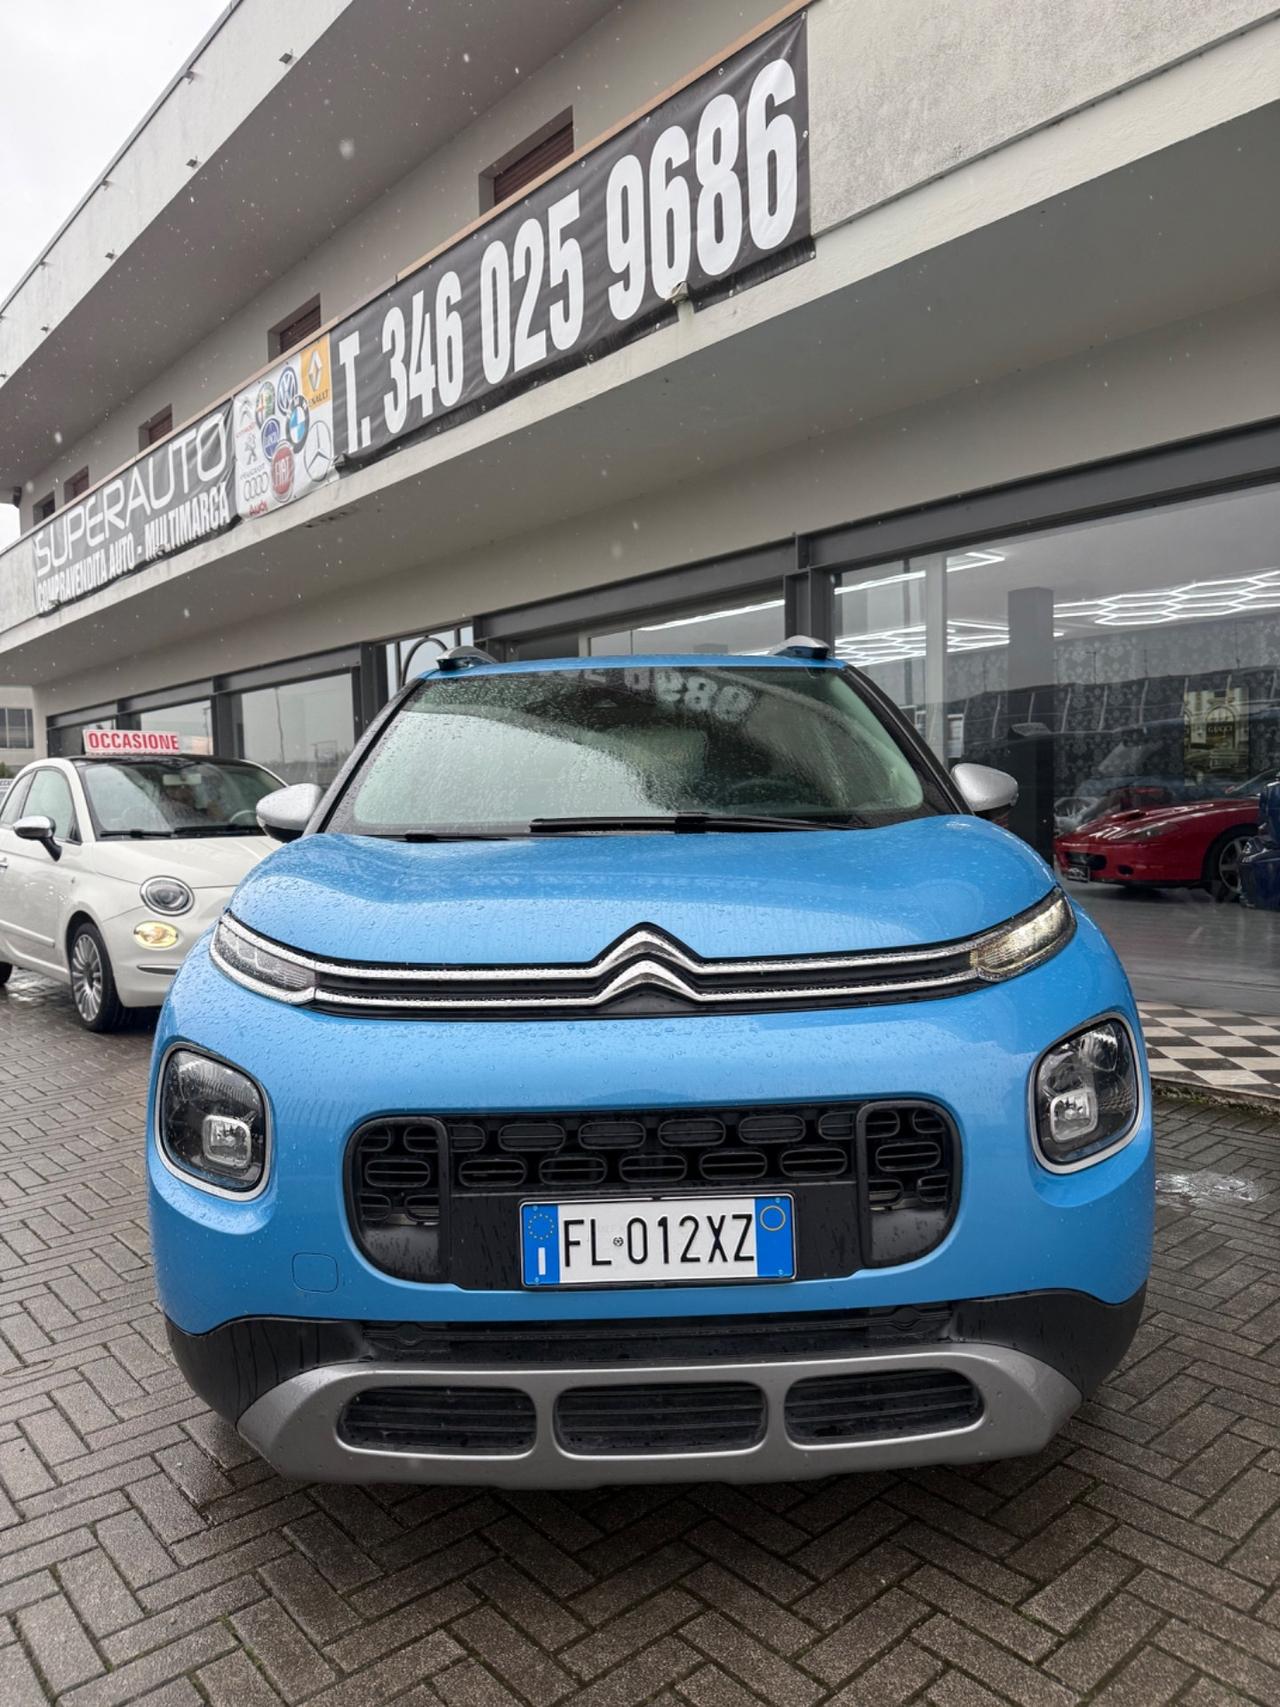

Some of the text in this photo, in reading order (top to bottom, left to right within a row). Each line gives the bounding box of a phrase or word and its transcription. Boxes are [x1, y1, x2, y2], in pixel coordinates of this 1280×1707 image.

[339, 58, 797, 454] T. 346 025 9686
[33, 412, 227, 577] SUPERAUTO
[36, 548, 108, 613] COMPRAVENDITA
[109, 532, 135, 580] AUTO
[144, 480, 231, 561] MULTIMARCA
[88, 732, 180, 750] OCCASIONE
